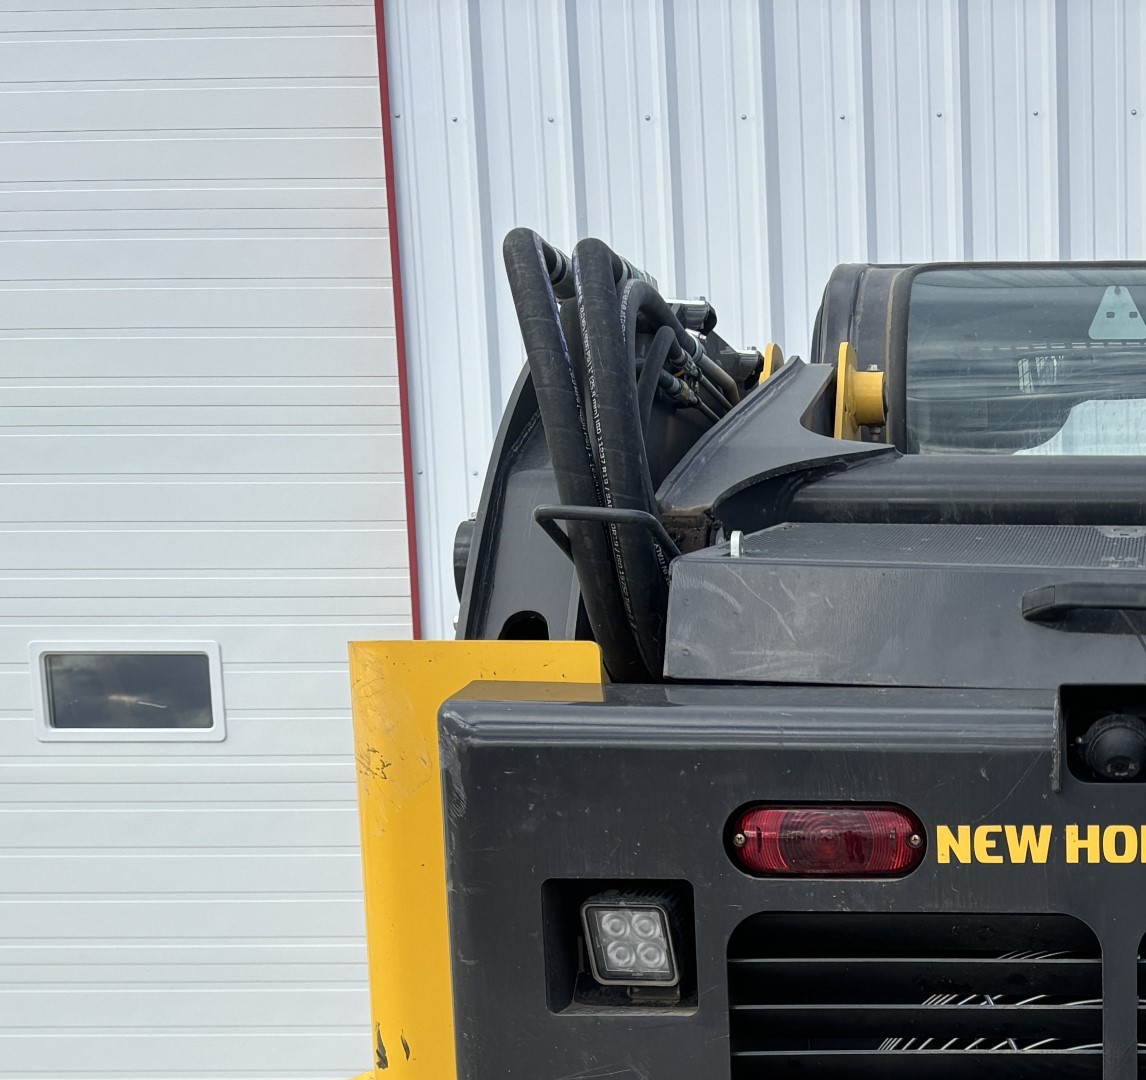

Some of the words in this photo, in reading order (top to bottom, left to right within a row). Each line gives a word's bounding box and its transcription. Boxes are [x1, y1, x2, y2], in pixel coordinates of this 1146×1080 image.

[601, 466, 609, 485] R19
[653, 543, 665, 565] ITALY
[936, 824, 1053, 864] NEW
